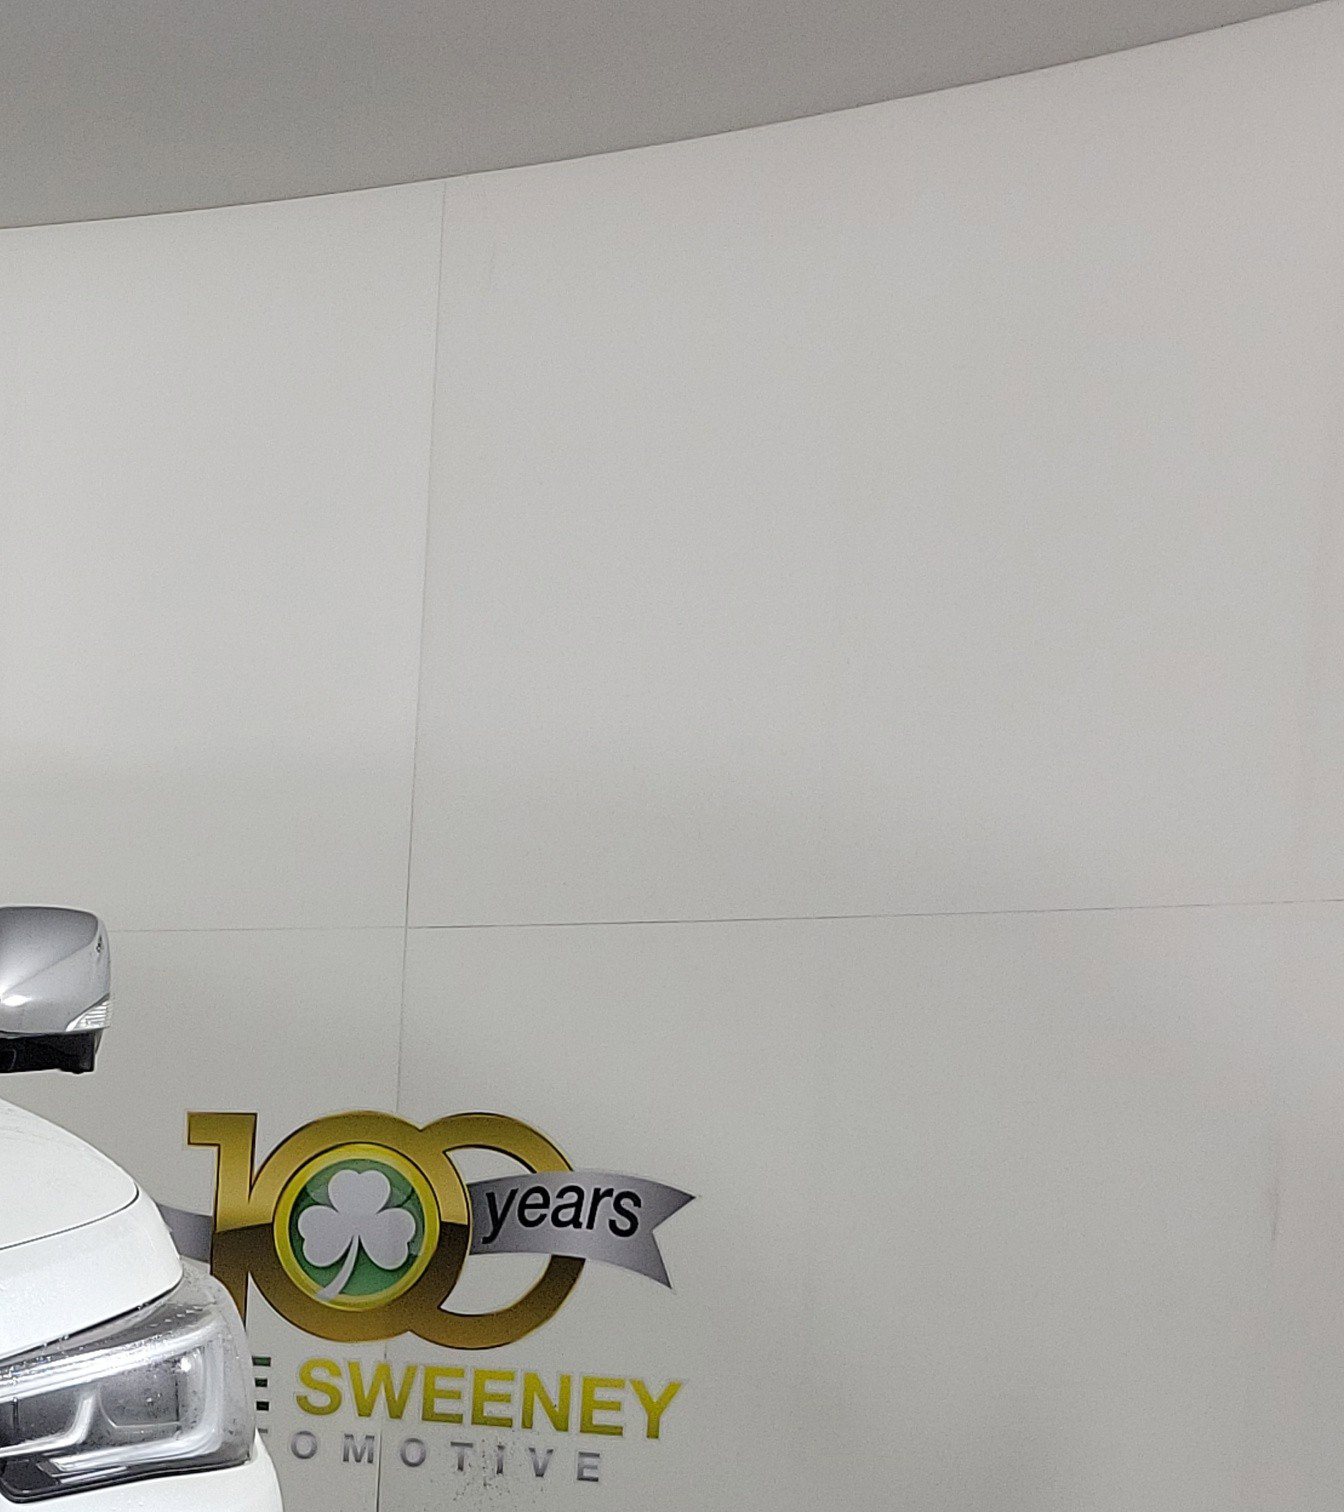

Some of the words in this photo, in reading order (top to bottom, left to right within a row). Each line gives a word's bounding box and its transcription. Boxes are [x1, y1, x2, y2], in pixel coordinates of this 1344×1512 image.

[482, 1184, 643, 1244] years
[296, 1356, 683, 1440] SWEENEY
[291, 1428, 602, 1484] OMOTIVE
